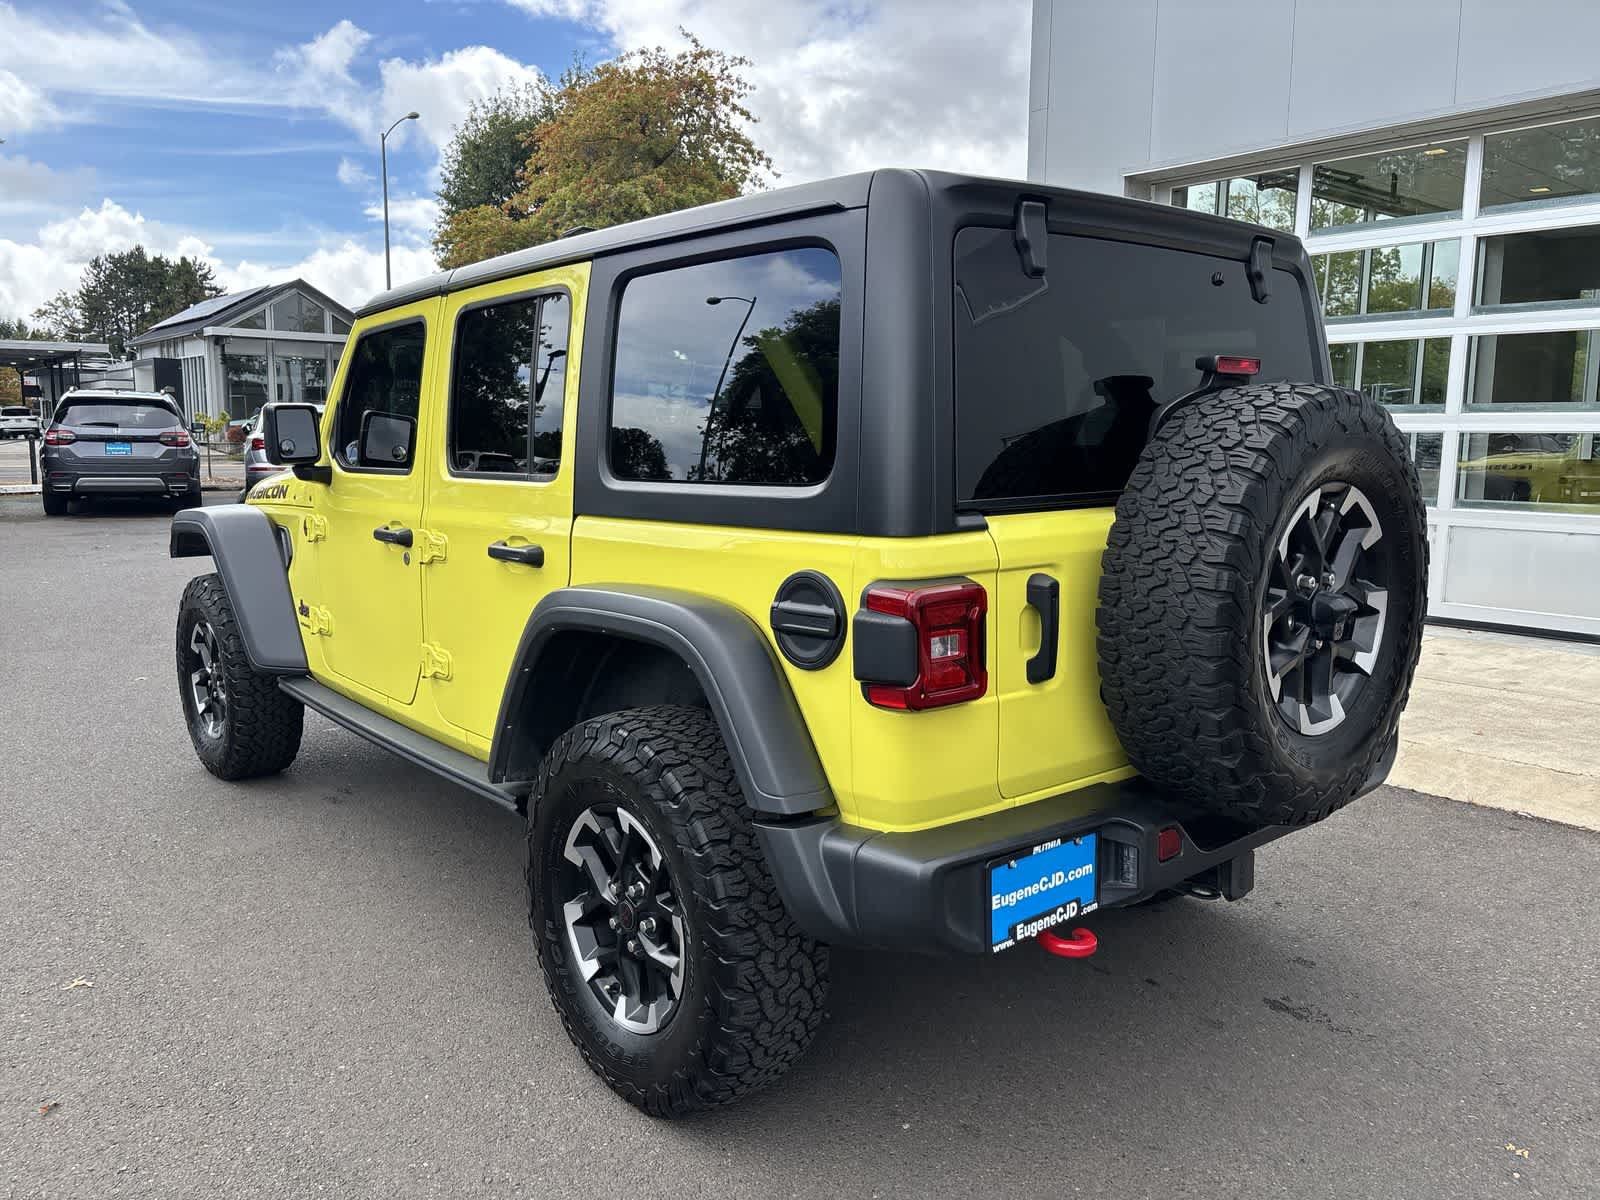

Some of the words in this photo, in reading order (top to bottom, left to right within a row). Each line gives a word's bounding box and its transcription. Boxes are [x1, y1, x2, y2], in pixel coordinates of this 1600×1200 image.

[992, 863, 1093, 910] EugeneCJD.com
[992, 938, 1015, 953] www.
[1016, 901, 1078, 941] EugeneCJD
[1080, 902, 1098, 916] .com
